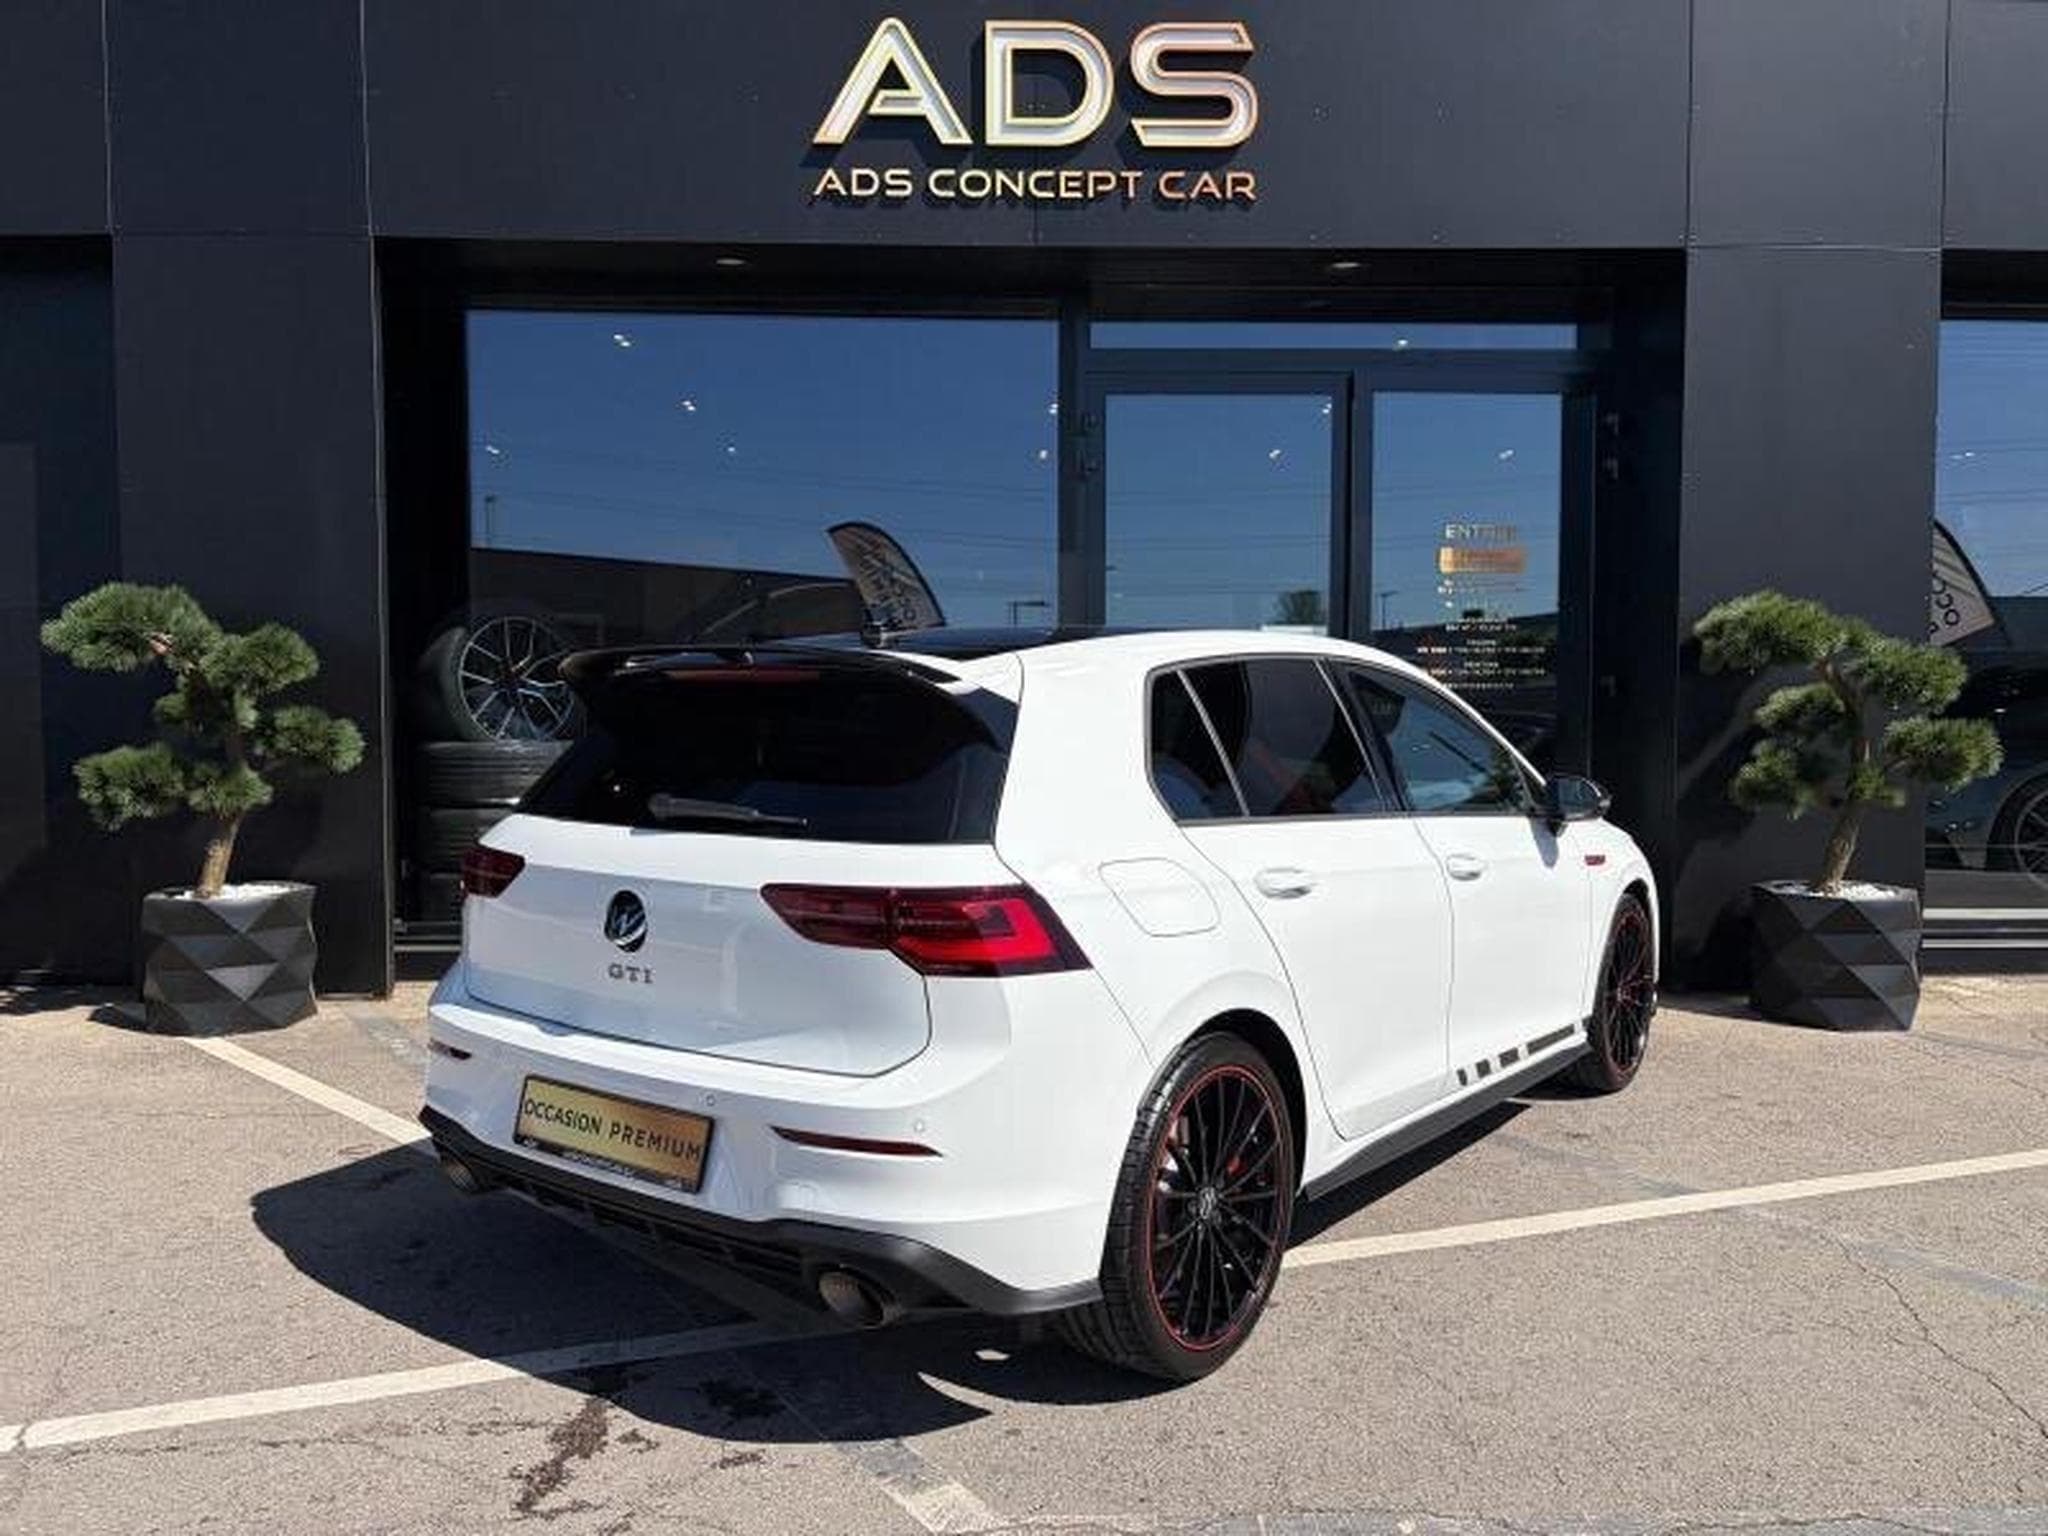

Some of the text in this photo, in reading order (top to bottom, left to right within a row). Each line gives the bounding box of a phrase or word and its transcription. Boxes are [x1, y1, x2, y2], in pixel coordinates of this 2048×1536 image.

[813, 16, 1259, 148] ADS
[814, 168, 1256, 200] ADS CONCEPT CAR
[608, 963, 653, 984] GTI
[523, 1098, 700, 1160] OCCASION PREMIUM
